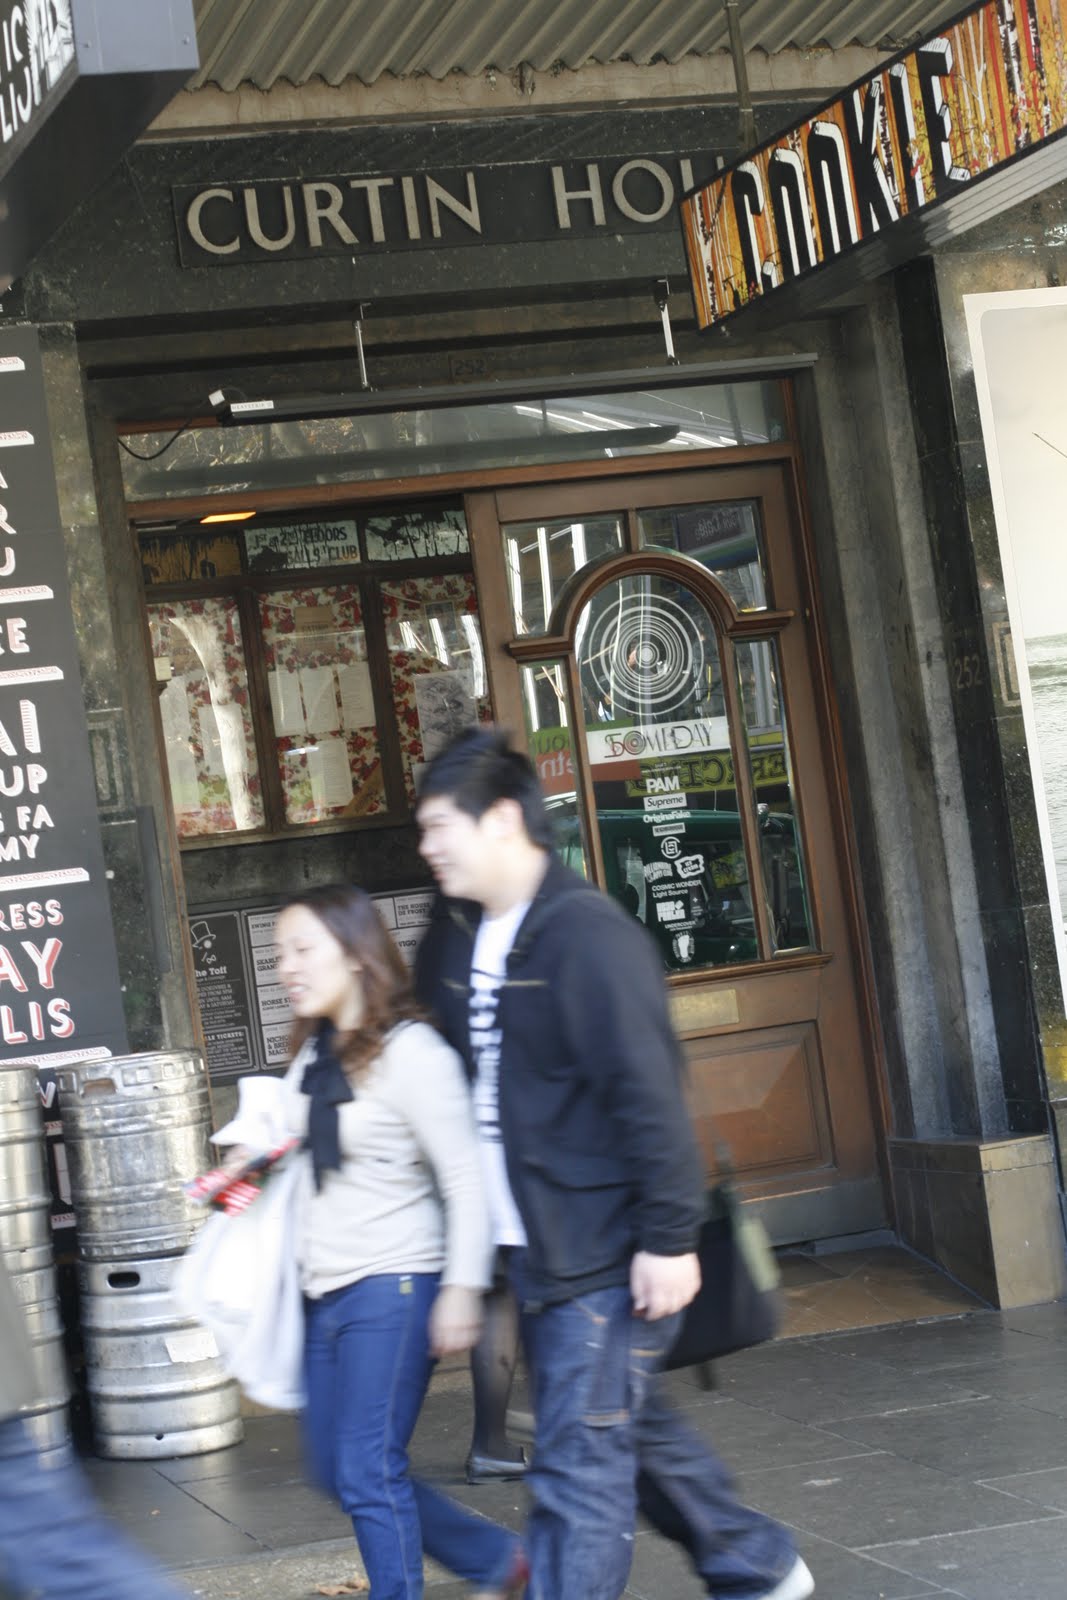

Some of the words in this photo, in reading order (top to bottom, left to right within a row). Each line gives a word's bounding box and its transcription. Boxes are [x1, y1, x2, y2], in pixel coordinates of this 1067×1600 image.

[186, 171, 482, 255] CURTIN
[954, 653, 982, 689] 252
[645, 775, 680, 794] PAM
[647, 796, 684, 808] Supreme
[16, 804, 55, 831] FA
[209, 965, 227, 975] Toff
[0, 997, 75, 1044] LIS
